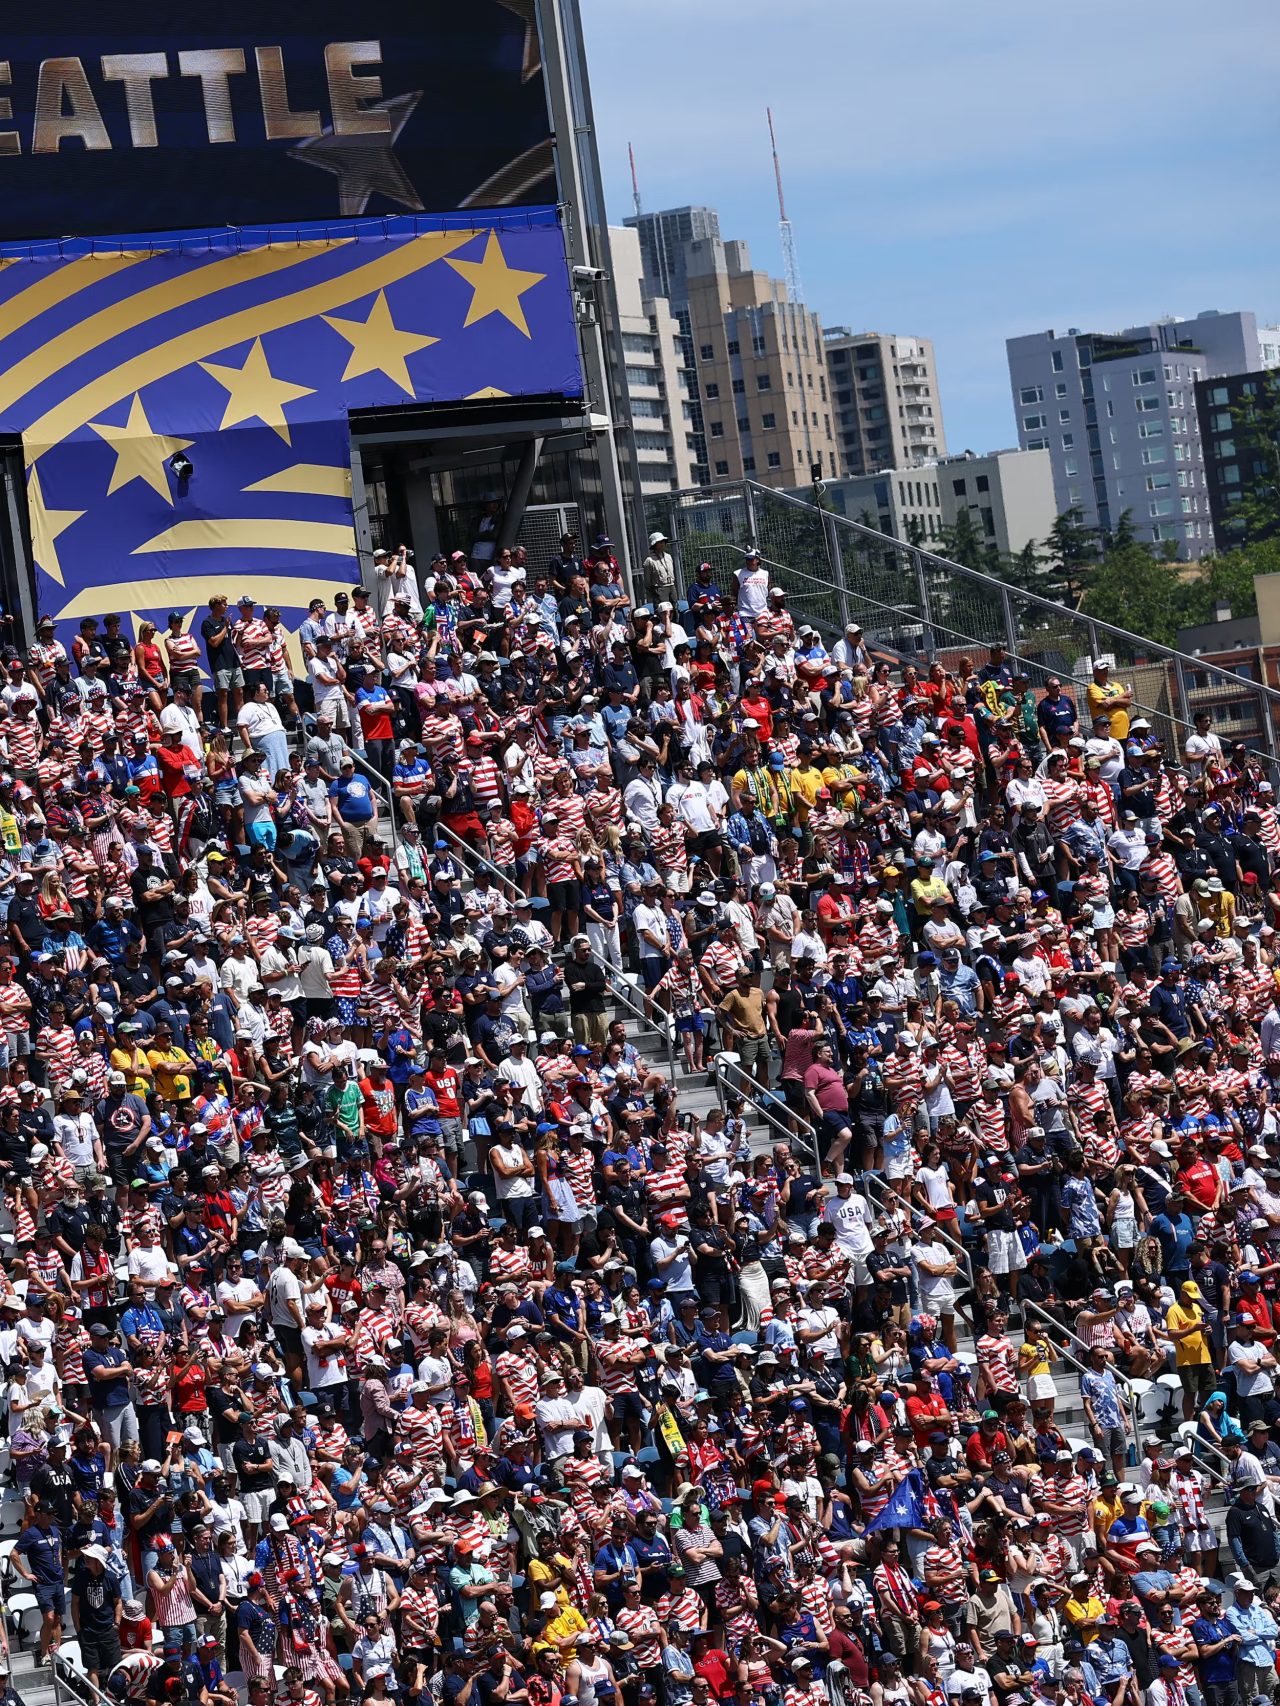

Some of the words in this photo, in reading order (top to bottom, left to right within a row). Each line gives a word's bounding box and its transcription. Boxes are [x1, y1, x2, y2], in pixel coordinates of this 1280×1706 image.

[436, 1077, 456, 1089] USA
[446, 1088, 456, 1100] 0
[839, 1207, 862, 1219] USA
[1203, 1276, 1215, 1285] 10
[331, 1287, 353, 1300] USA
[525, 1367, 533, 1377] 10
[391, 1375, 413, 1390] USA
[52, 1475, 71, 1486] USA
